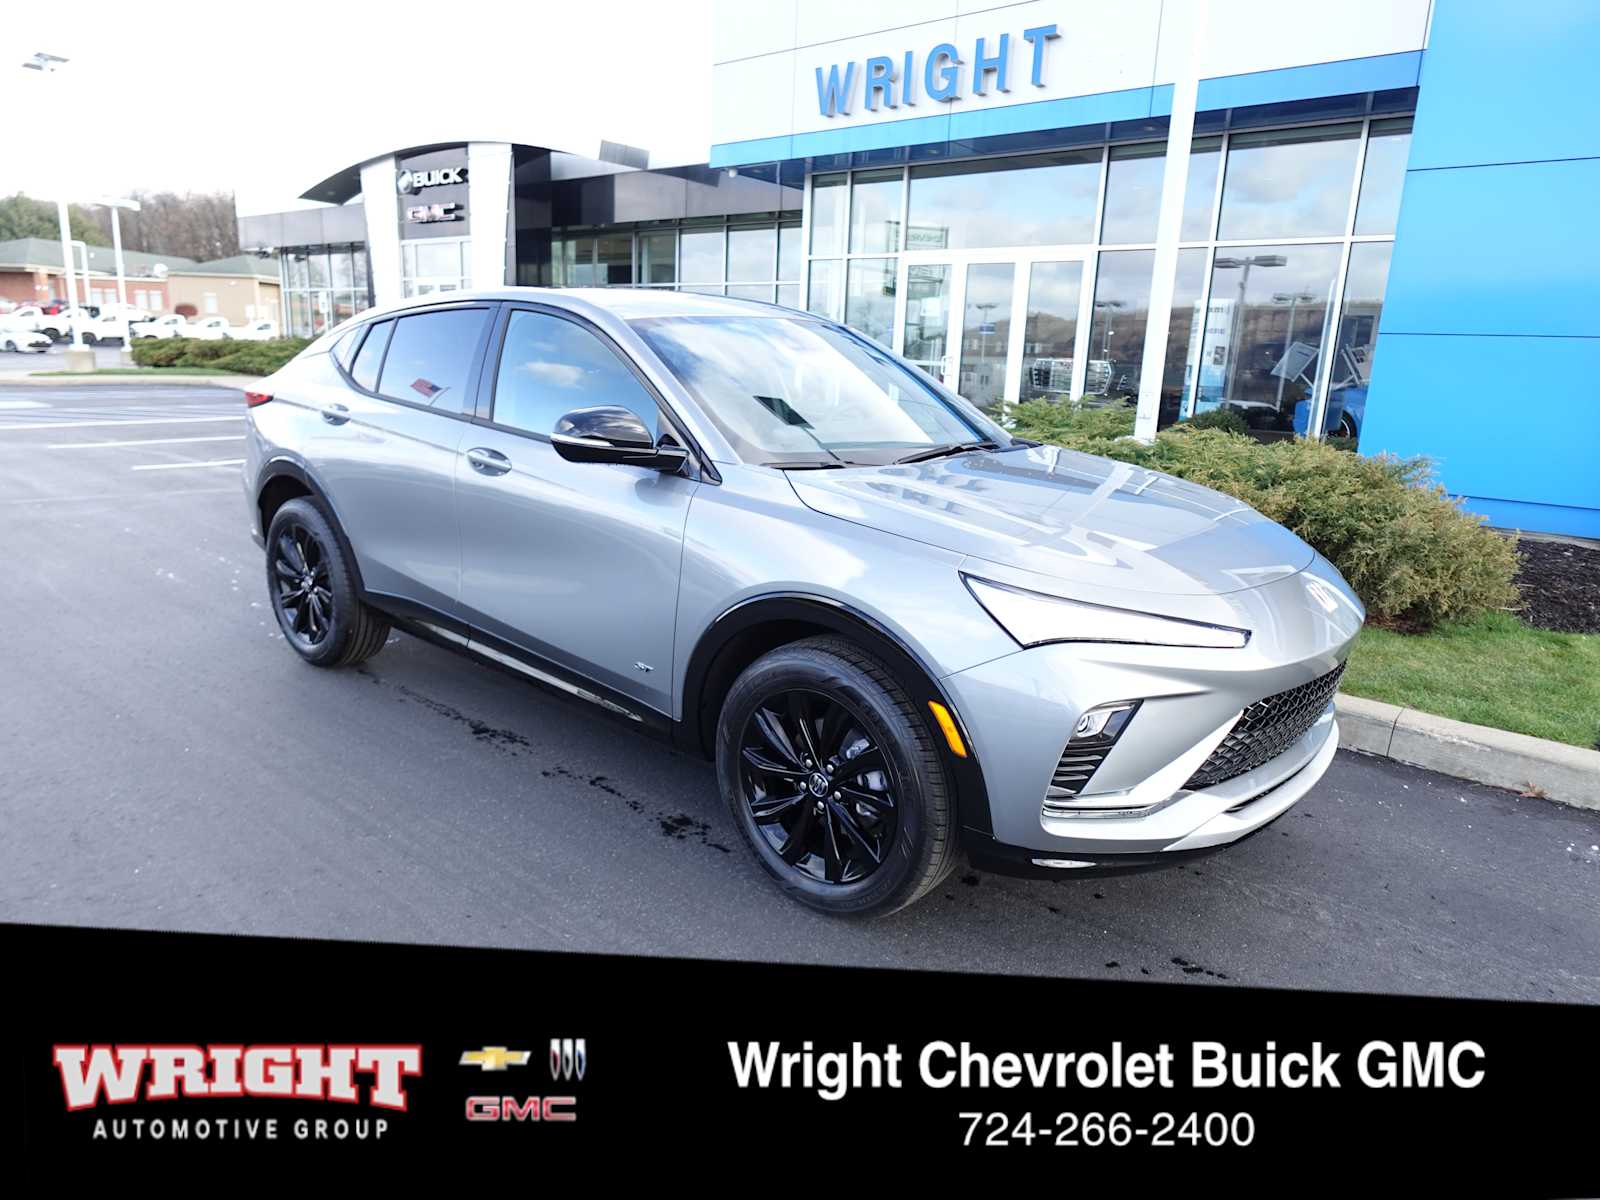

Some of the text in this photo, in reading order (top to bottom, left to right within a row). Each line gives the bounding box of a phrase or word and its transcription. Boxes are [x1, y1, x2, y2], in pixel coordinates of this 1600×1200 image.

[815, 24, 1059, 117] WRIGHT
[413, 167, 463, 188] BUICK
[407, 202, 456, 223] GMC
